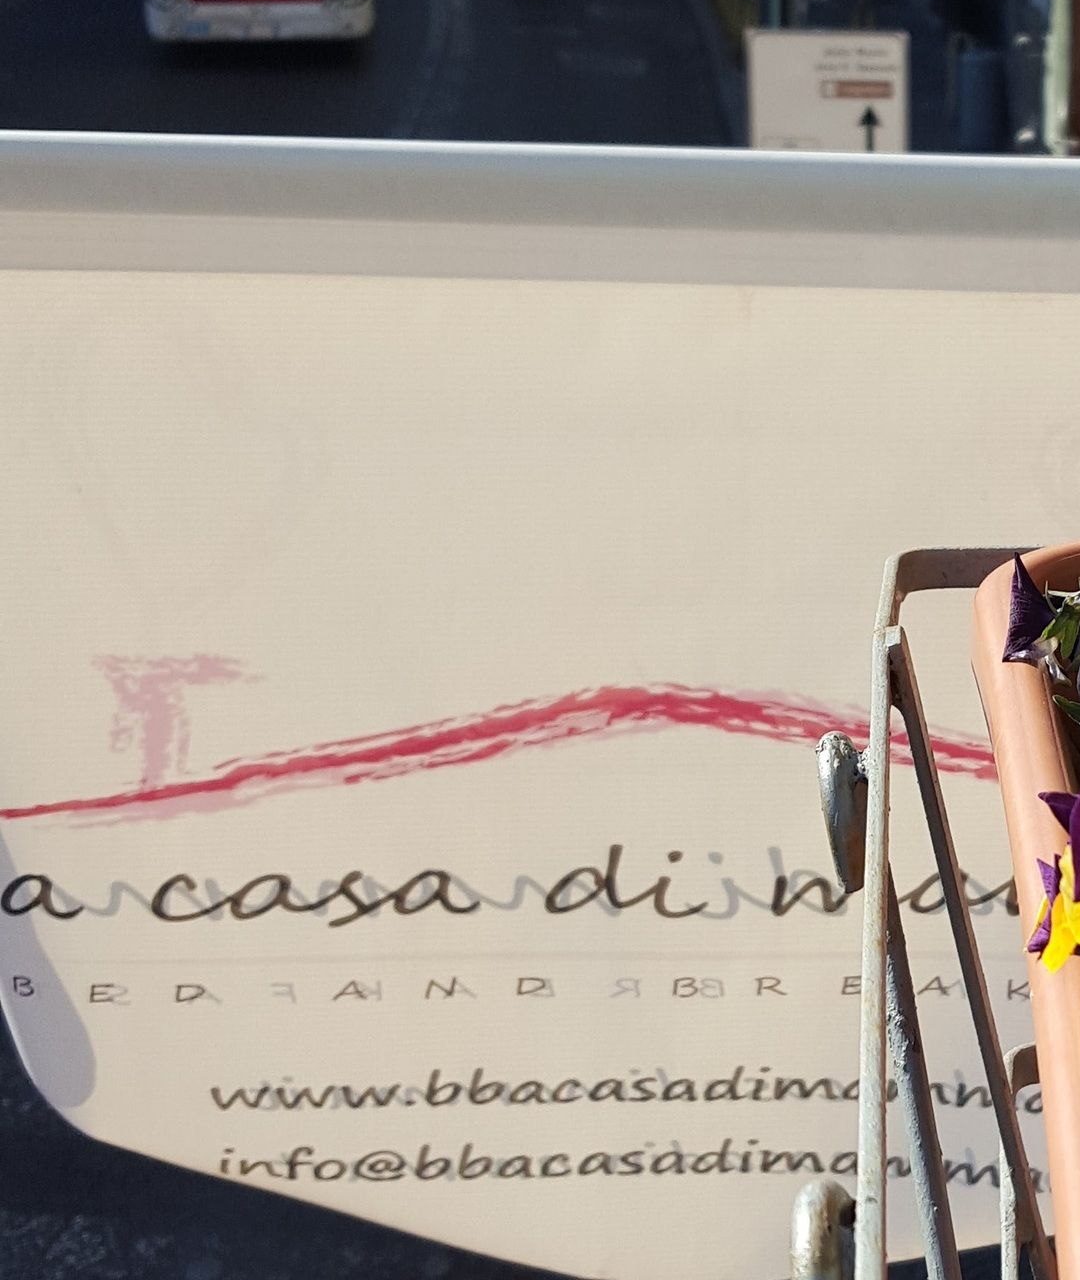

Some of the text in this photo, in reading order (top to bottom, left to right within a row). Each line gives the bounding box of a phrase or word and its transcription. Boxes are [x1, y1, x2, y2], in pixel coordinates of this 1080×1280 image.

[0, 873, 84, 920] a
[151, 869, 481, 928] casa
[545, 844, 707, 920] di
[12, 975, 207, 1004] BED
[333, 976, 547, 1003] AND
